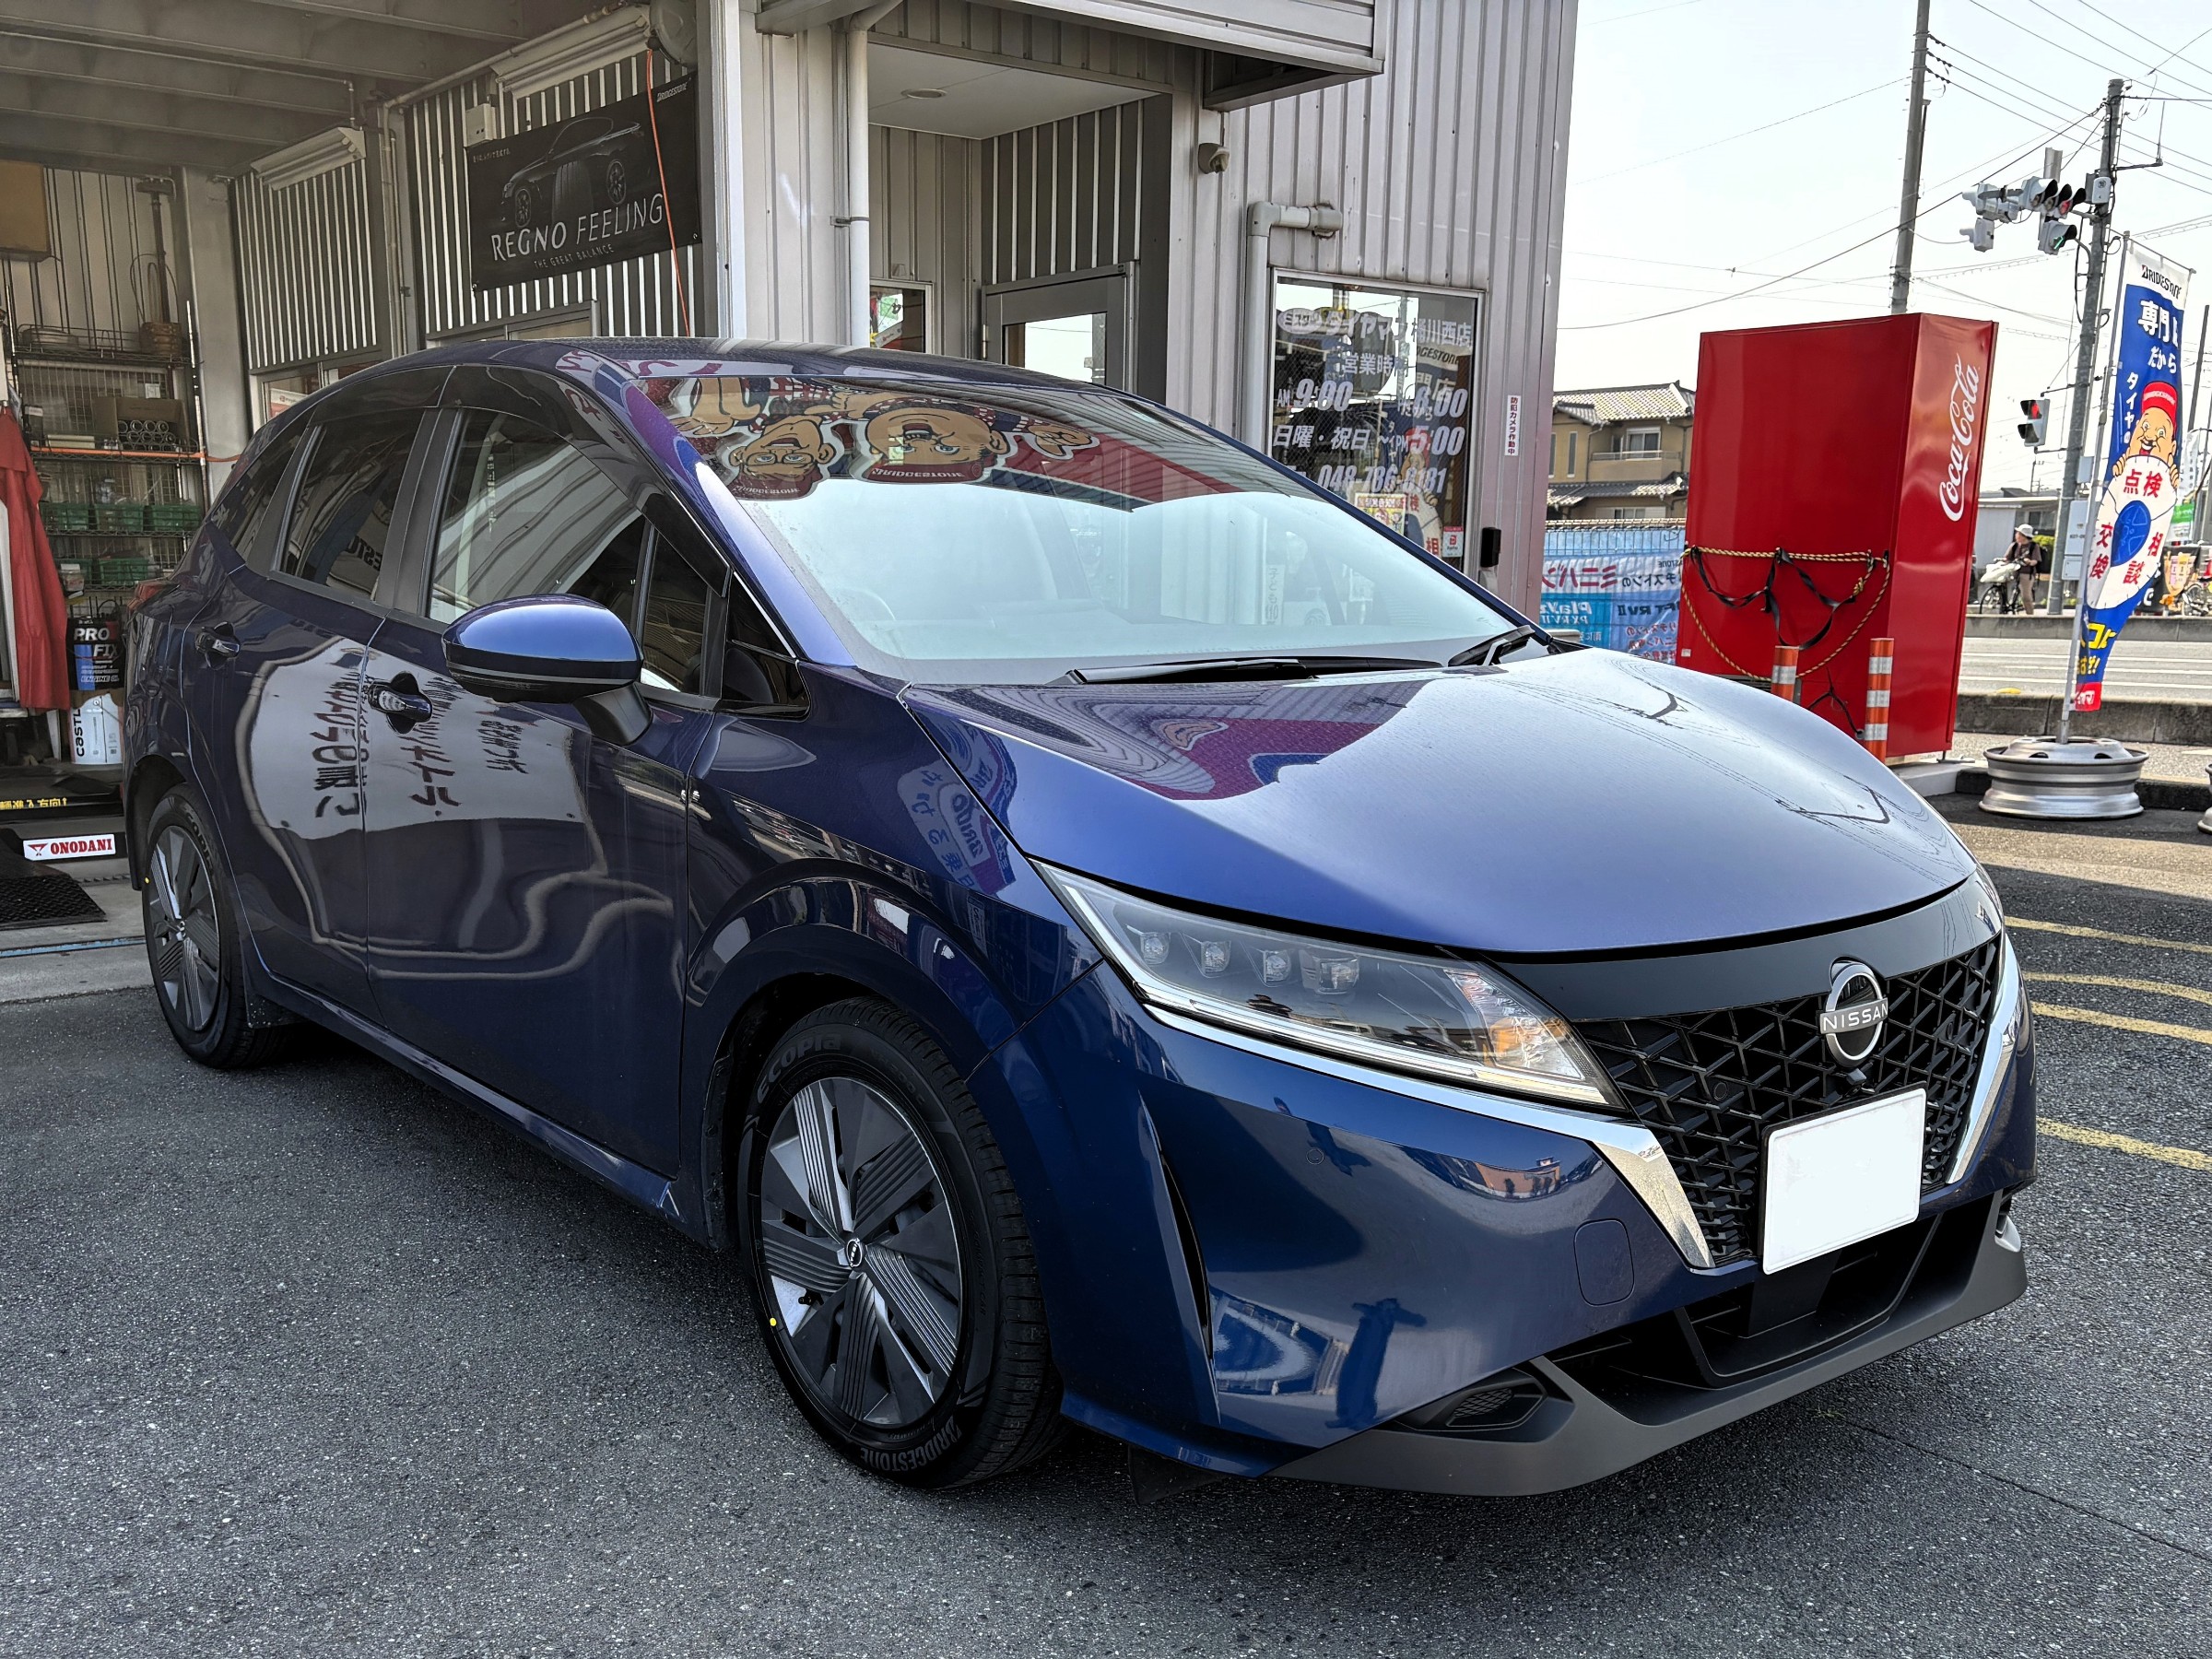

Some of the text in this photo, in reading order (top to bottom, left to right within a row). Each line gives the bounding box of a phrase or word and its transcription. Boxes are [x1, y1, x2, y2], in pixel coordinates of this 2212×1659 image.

[490, 193, 665, 262] REGNO FEELING
[534, 244, 615, 270] THE GREAT BALANCE
[1272, 424, 1371, 451] 日曜・祝日
[1508, 396, 1519, 455] 防犯カメラ作動中
[1939, 352, 1980, 523] Coca-Cola
[2123, 468, 2163, 499] 点検
[73, 628, 109, 642] PRO
[92, 643, 117, 657] FIX
[50, 839, 112, 855] ONODANI
[1822, 1005, 1888, 1031] NISSAN
[860, 1416, 962, 1472] BRIDGESTONE
